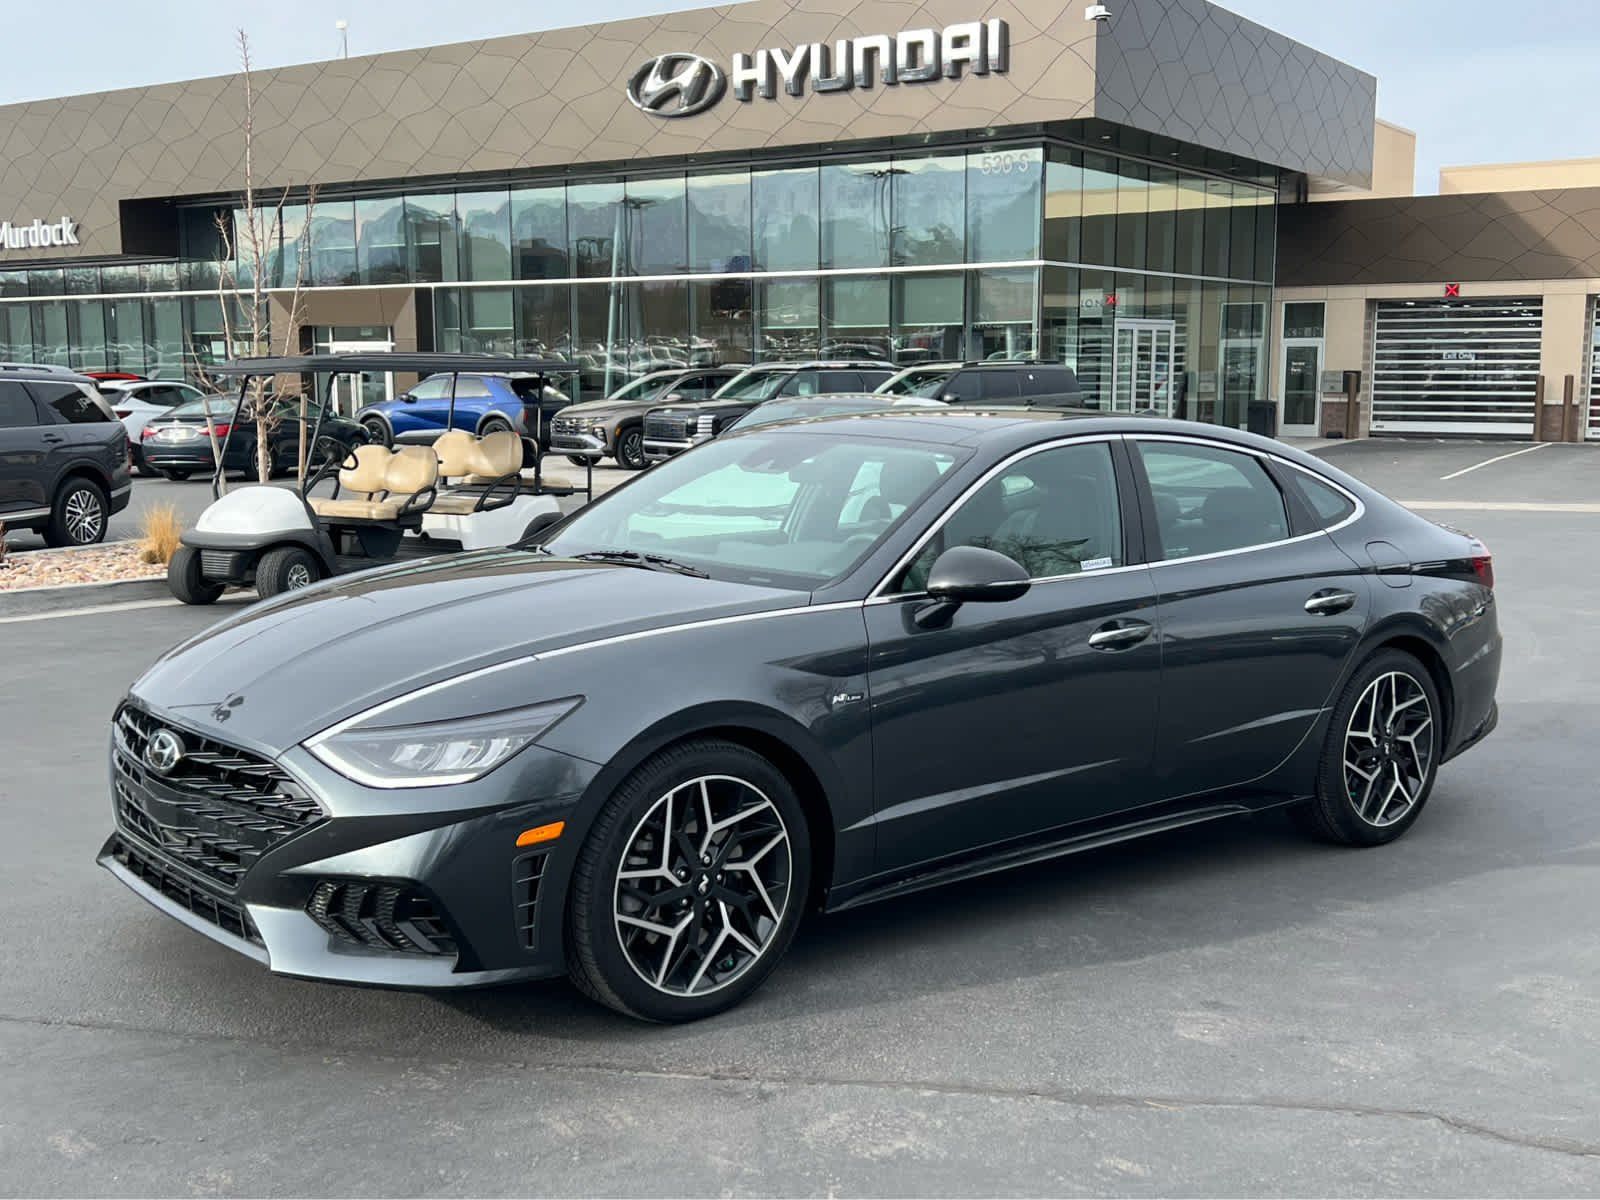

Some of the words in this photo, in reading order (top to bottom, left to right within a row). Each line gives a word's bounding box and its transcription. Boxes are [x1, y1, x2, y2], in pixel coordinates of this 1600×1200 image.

[732, 17, 1009, 102] HYUNDAI
[982, 154, 1013, 174] 530
[1019, 152, 1029, 172] S
[1458, 351, 1476, 361] Only
